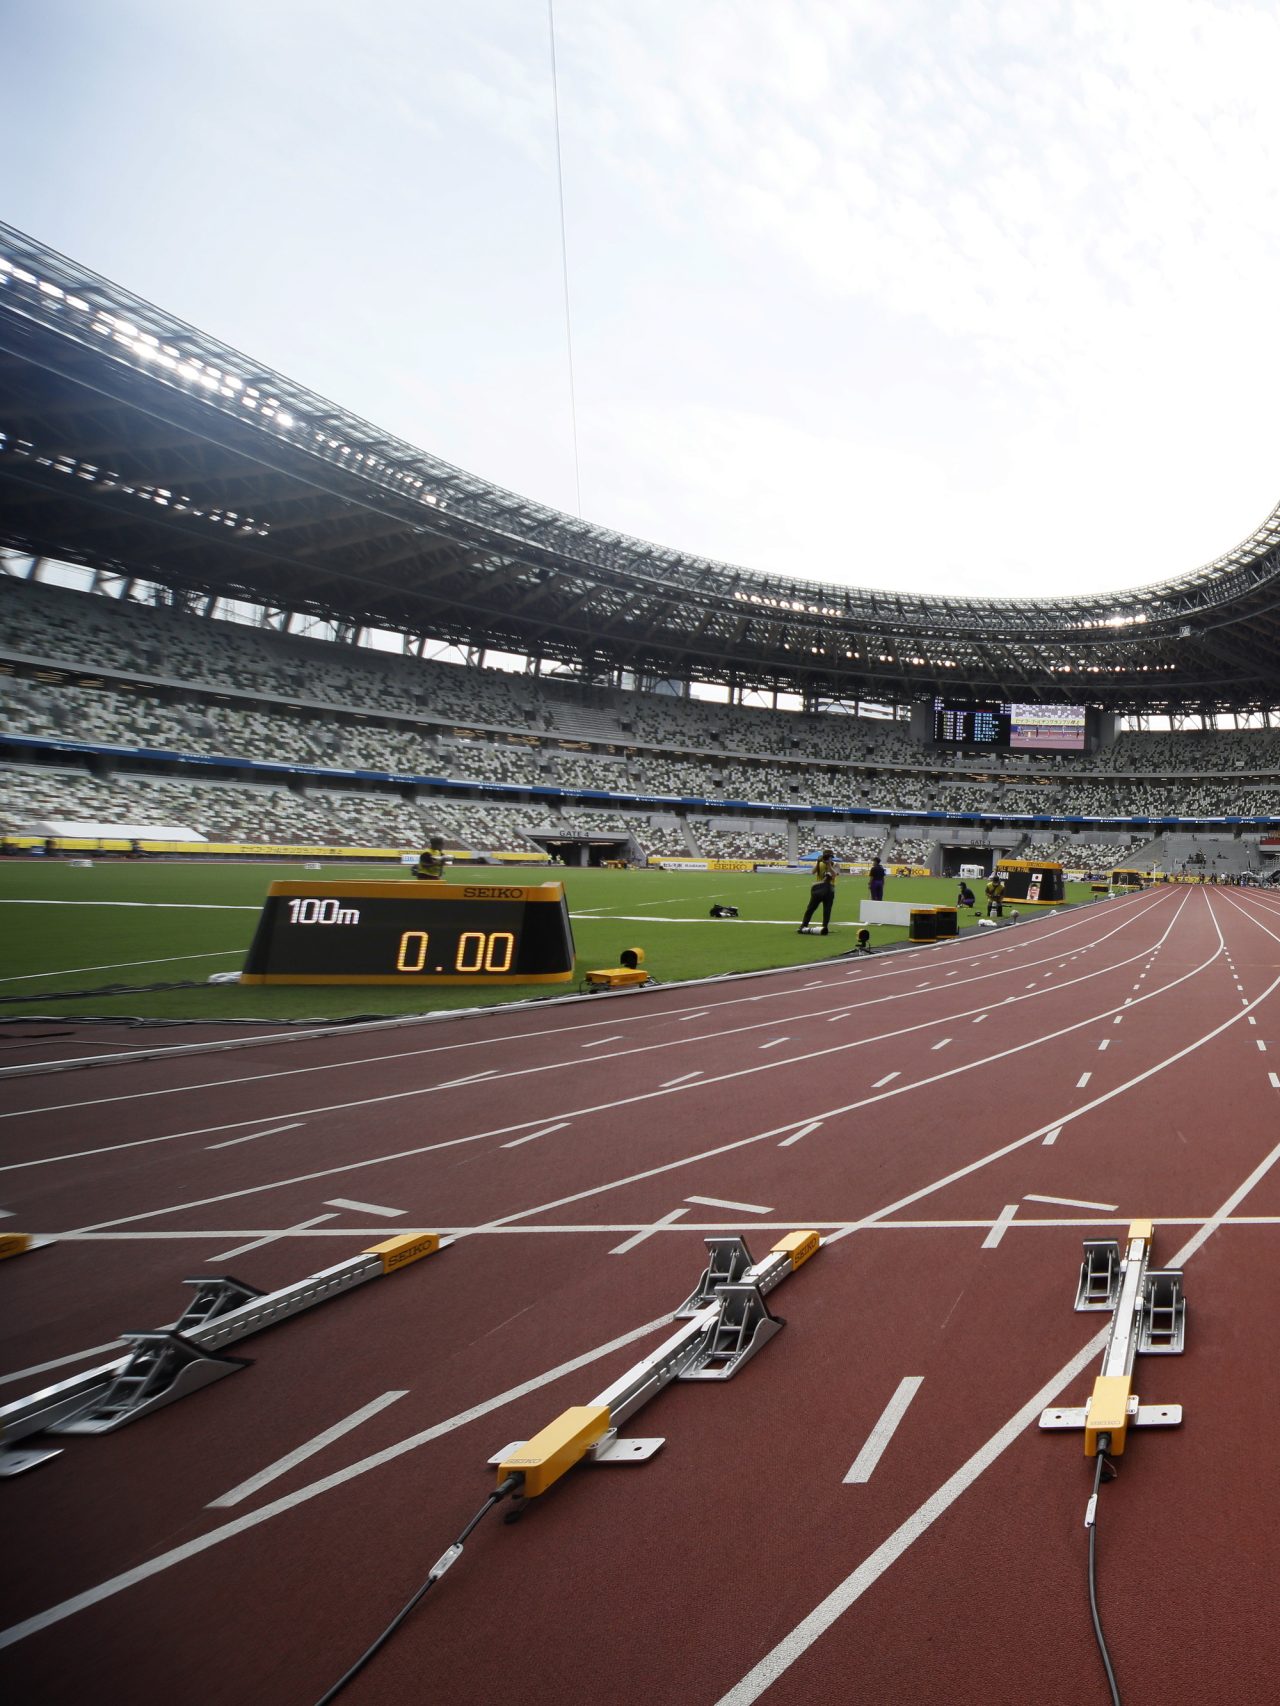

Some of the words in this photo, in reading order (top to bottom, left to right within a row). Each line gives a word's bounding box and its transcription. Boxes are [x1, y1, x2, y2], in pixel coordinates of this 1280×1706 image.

[463, 887, 523, 899] SEIKO
[288, 899, 360, 925] 100m
[388, 1239, 433, 1267] SEIKO
[794, 1236, 817, 1264] SEIKO
